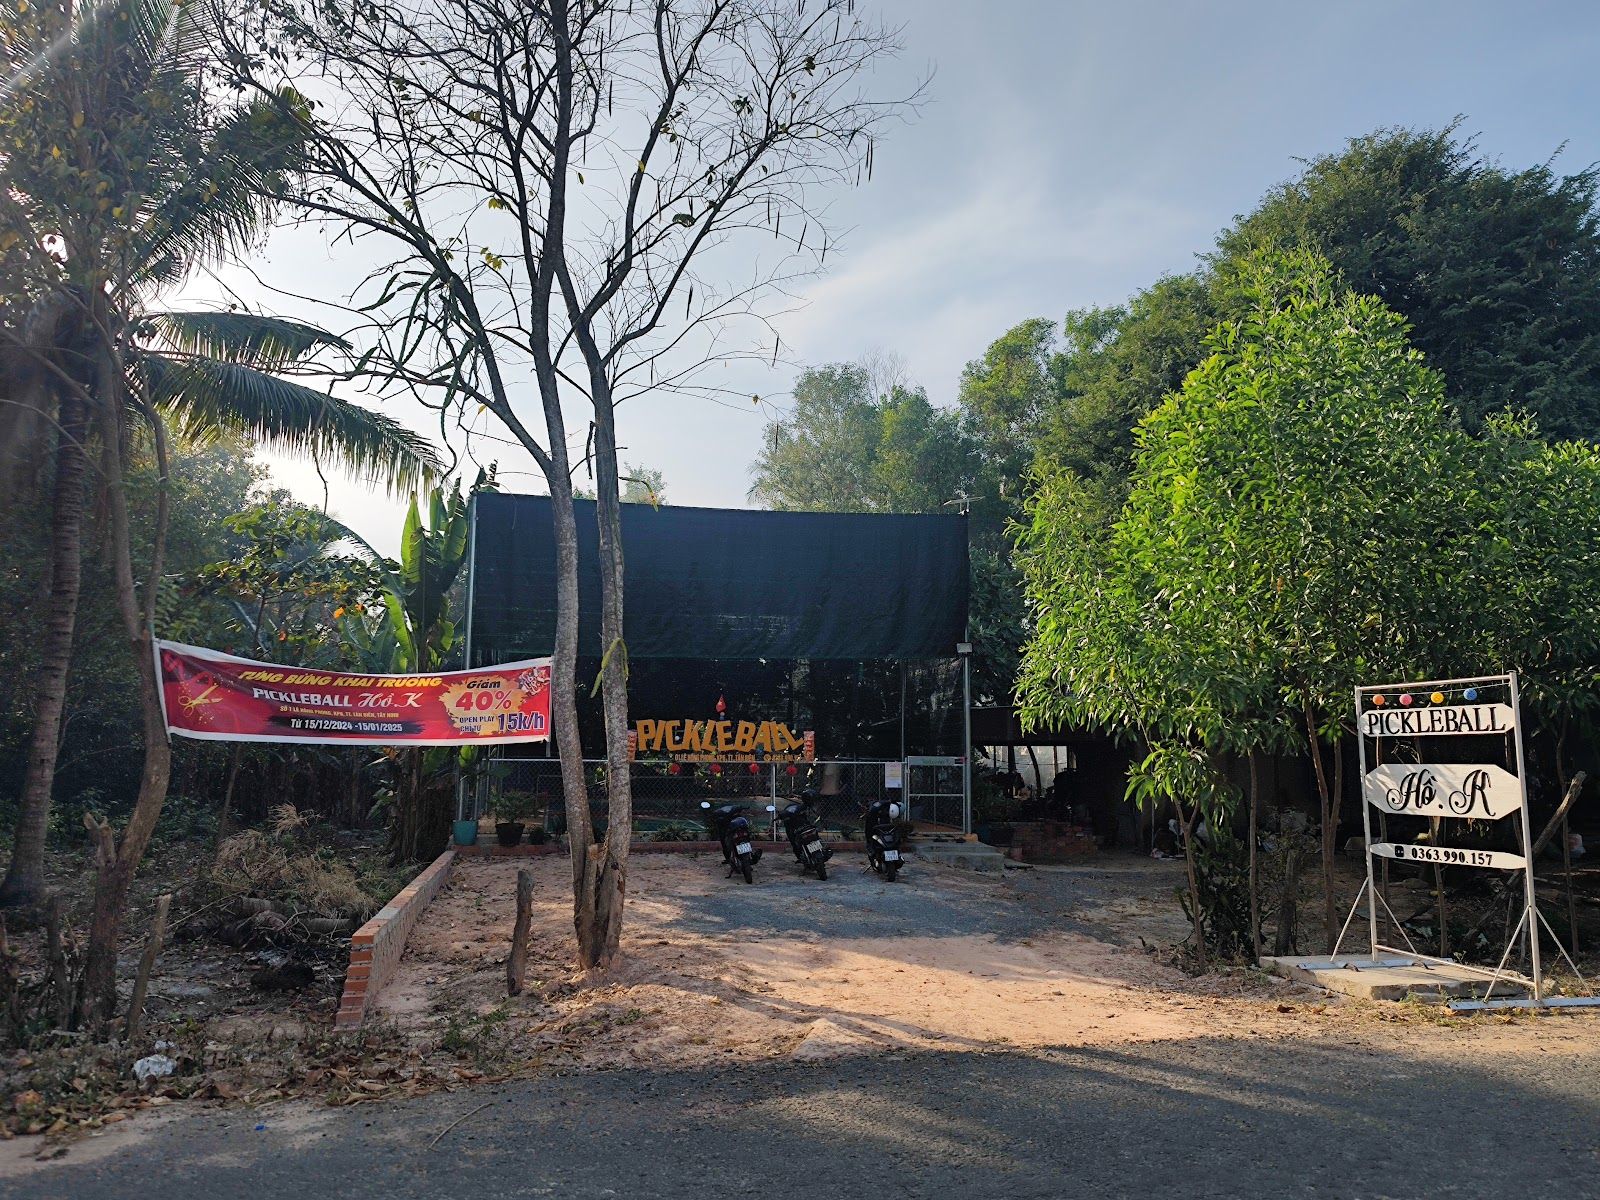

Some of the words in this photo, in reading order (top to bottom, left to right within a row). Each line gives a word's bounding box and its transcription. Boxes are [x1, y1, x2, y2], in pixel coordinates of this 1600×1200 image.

[332, 677, 375, 687] KHAI
[252, 687, 353, 707] PICKLEBALL
[456, 690, 512, 711] 40%
[304, 719, 353, 730] 15/12/2024
[498, 711, 544, 731] 15k/h
[1367, 707, 1506, 735] PICKLEBALL
[636, 719, 805, 752] PICKLEBALL
[1411, 847, 1493, 866] 0363.990.157
